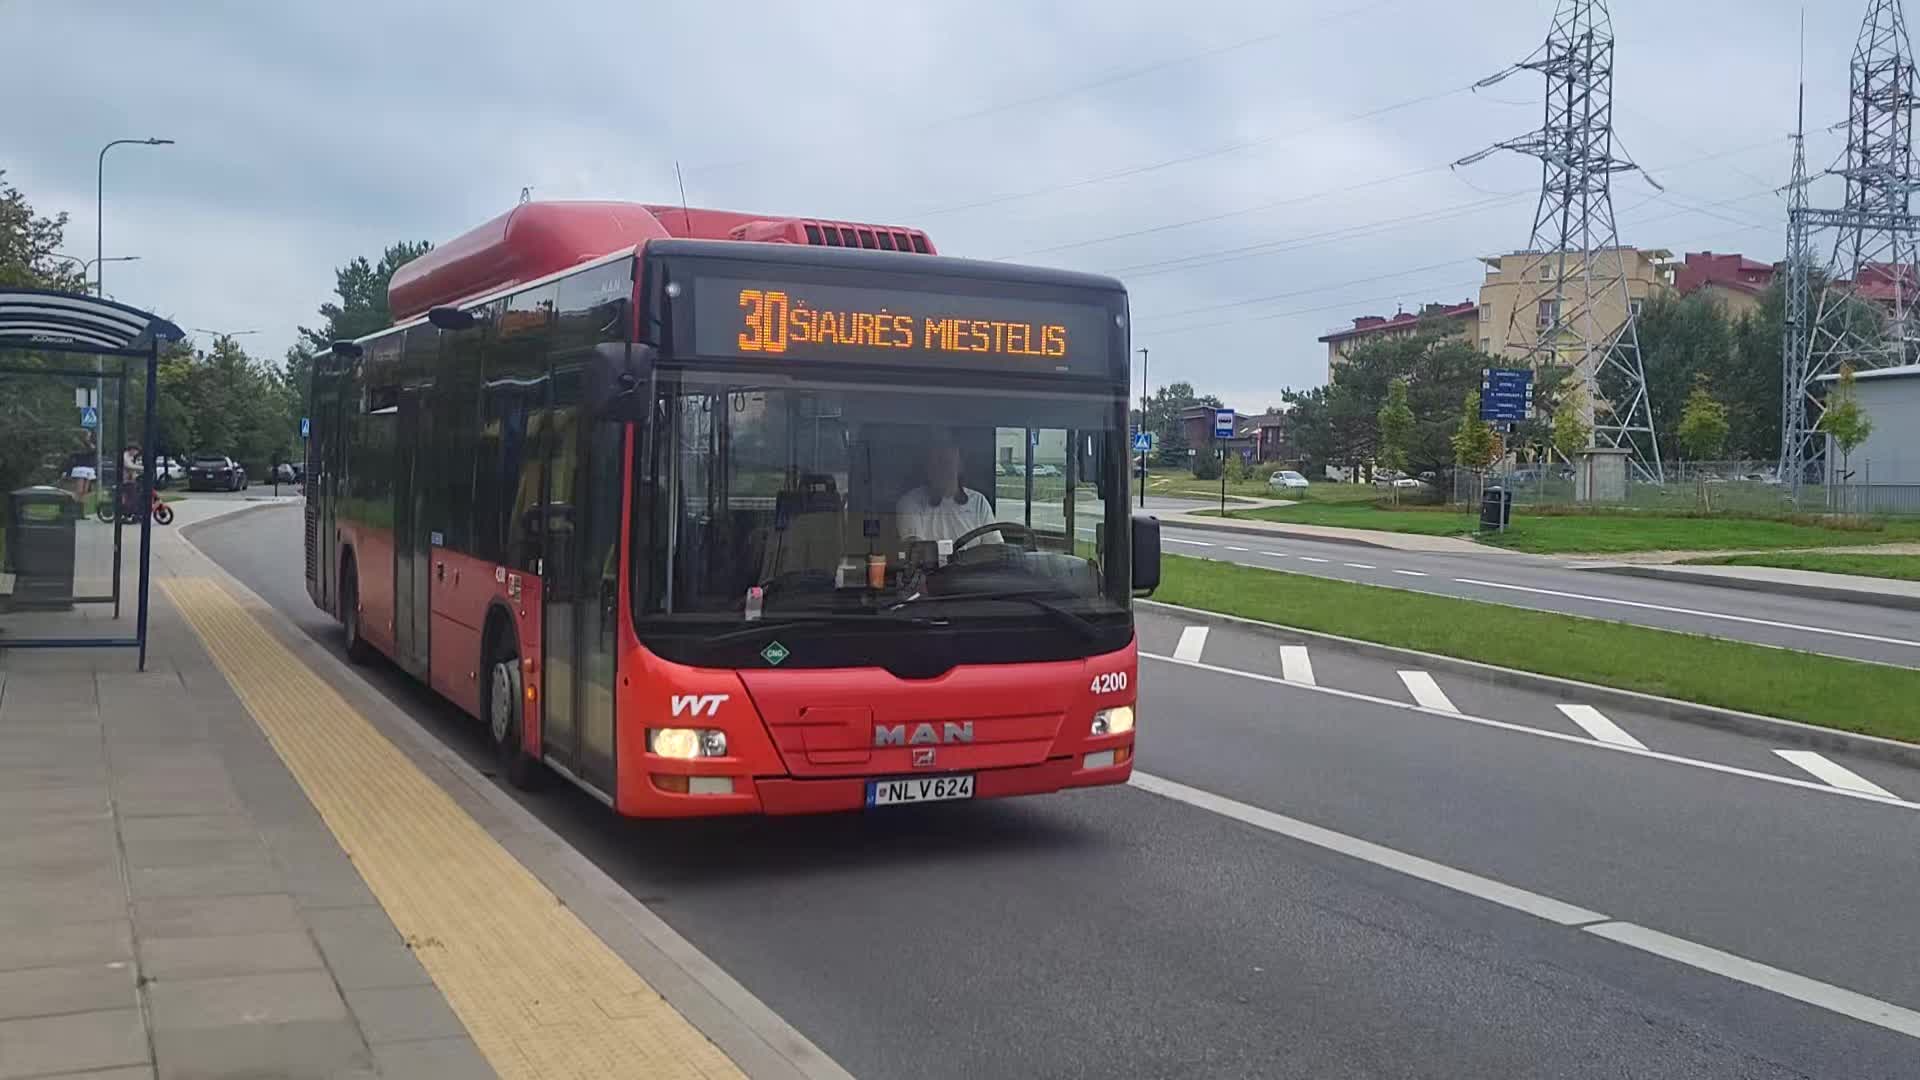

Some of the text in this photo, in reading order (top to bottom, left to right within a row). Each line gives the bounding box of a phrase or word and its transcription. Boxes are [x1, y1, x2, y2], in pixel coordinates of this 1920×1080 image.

[738, 289, 1066, 356] 30 ŠIAURĖS MIESTELIS
[1090, 671, 1127, 695] 4200
[875, 720, 974, 746] MAN
